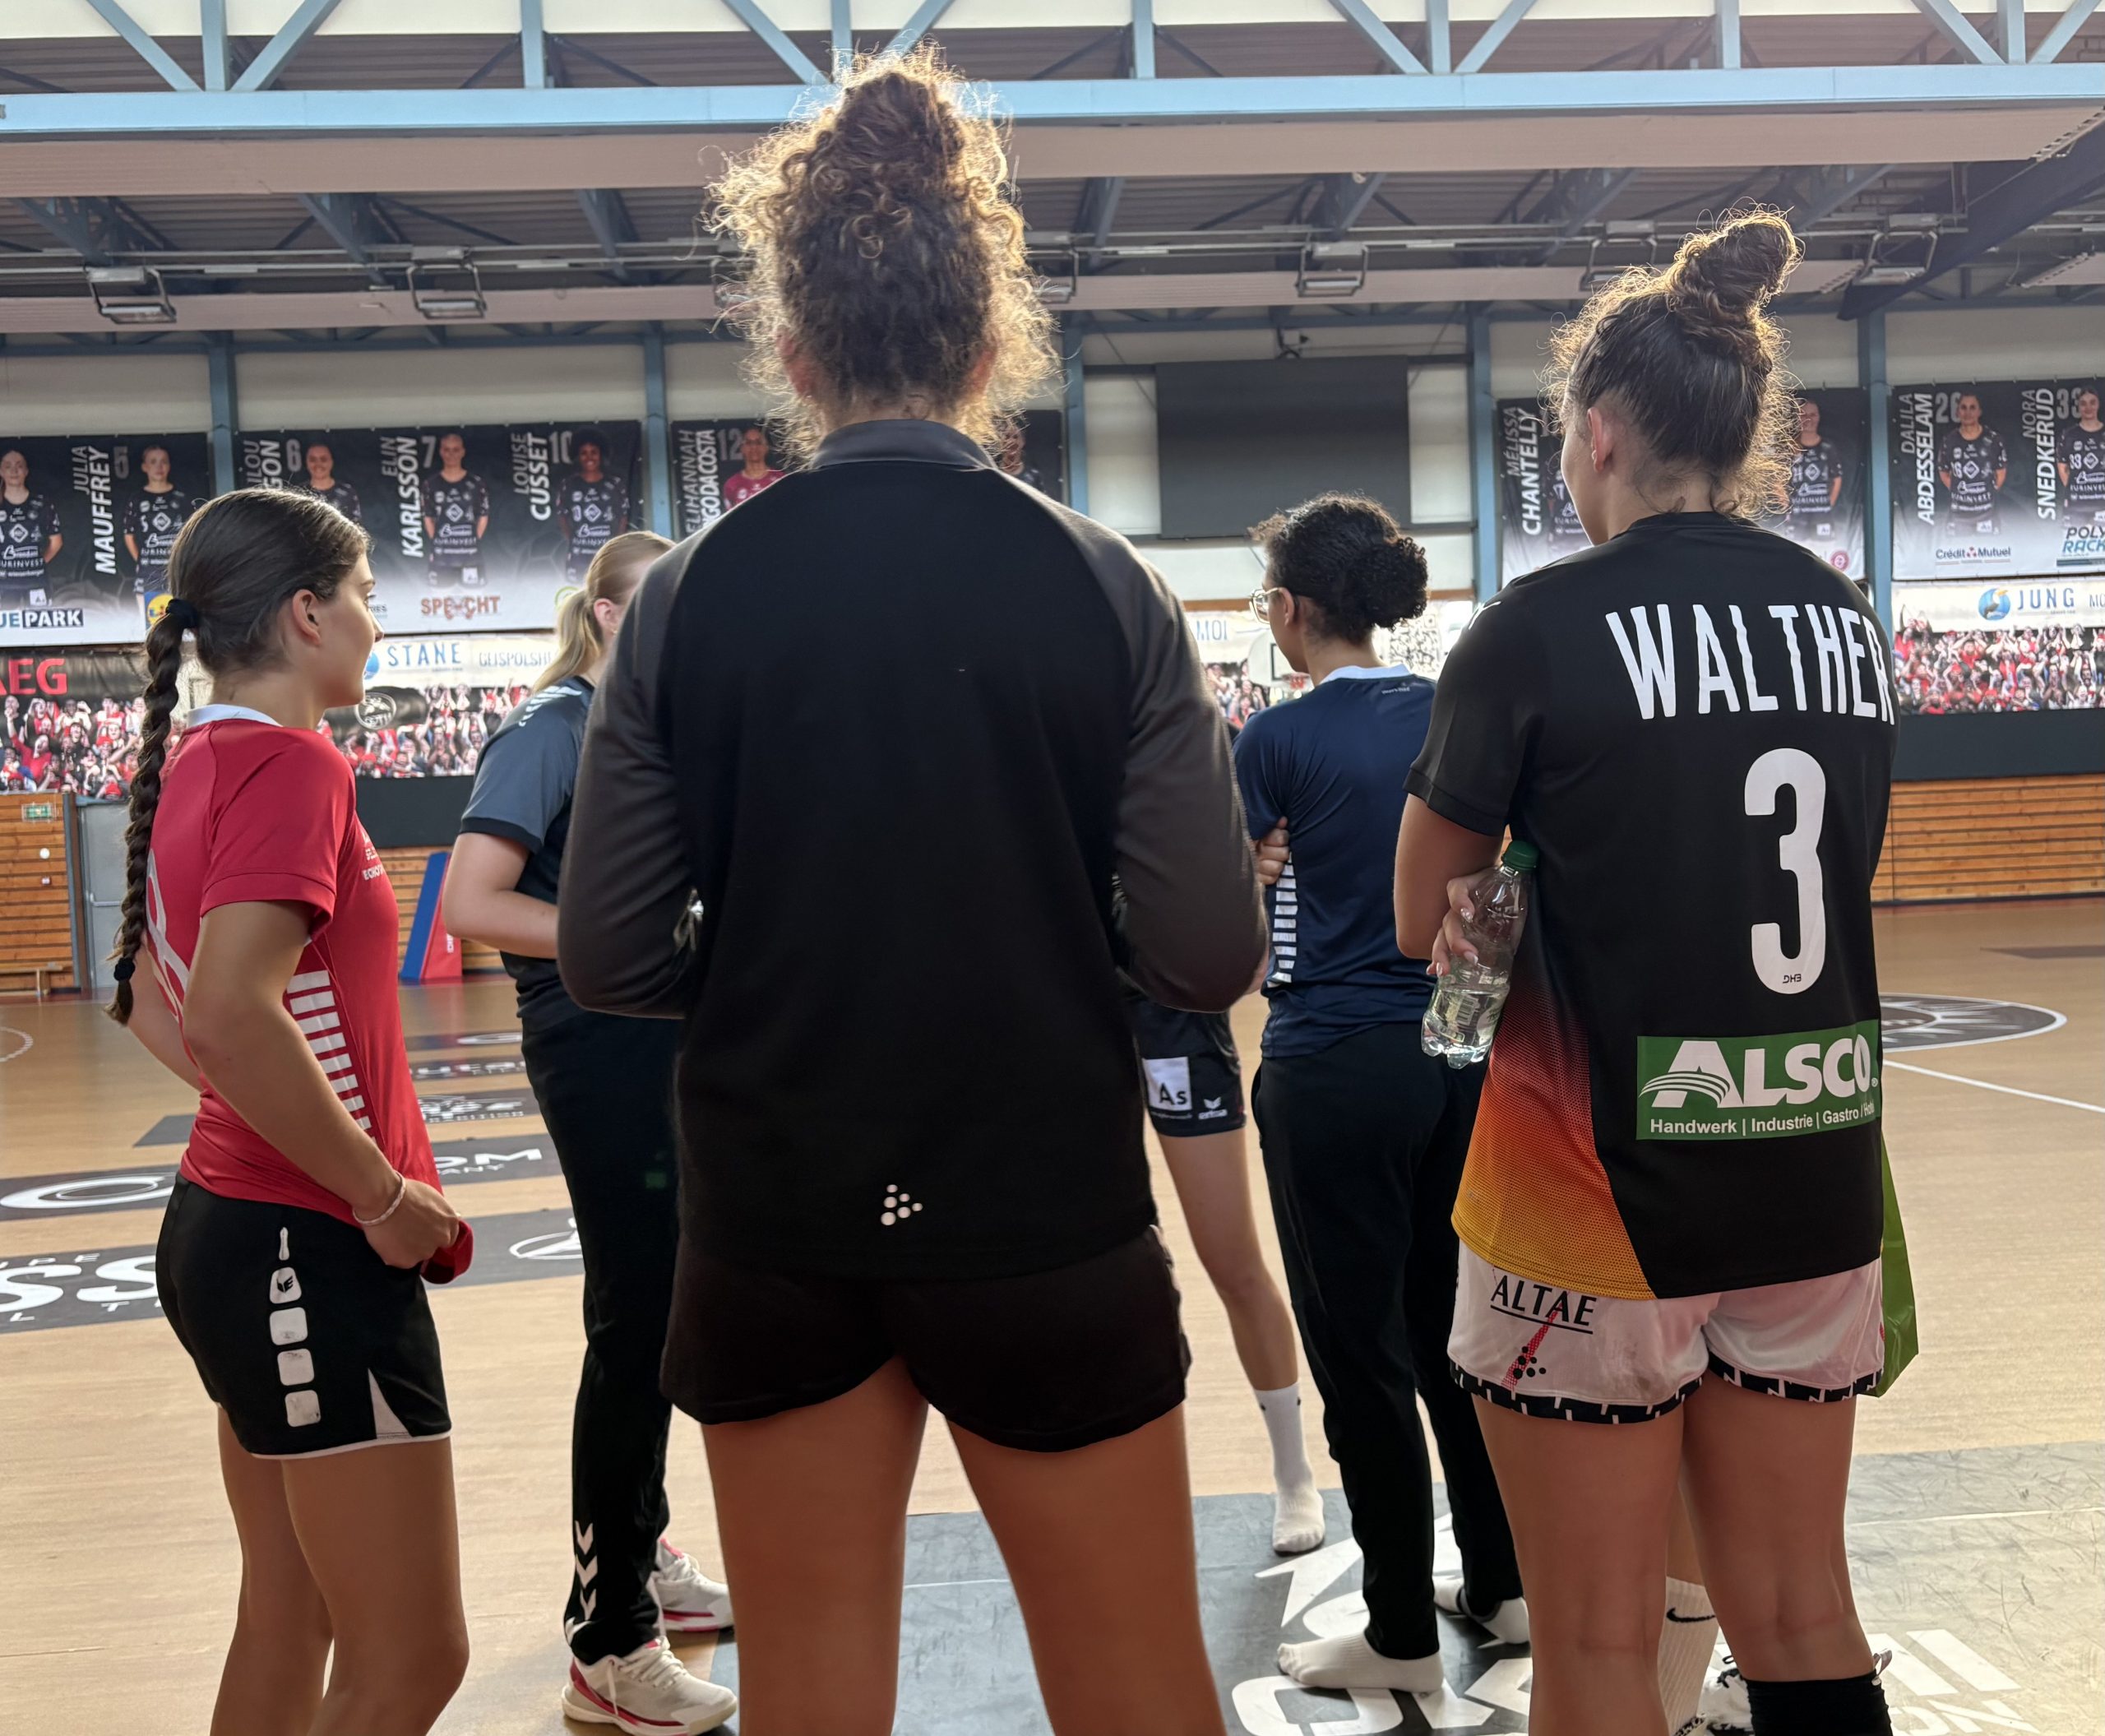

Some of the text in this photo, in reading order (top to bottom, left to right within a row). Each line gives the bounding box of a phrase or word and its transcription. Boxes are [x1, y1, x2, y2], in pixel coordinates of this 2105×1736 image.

[1899, 393, 1915, 453] DALILA
[2021, 389, 2037, 439] NORA
[113, 447, 129, 479] 5
[380, 436, 398, 477] ELIN
[421, 436, 437, 469] 7
[511, 432, 530, 494] LOUISE
[696, 429, 717, 475] COSTA
[717, 428, 743, 461] 12
[1914, 392, 1935, 525] ABDESSELAM
[2035, 388, 2056, 521] SNEDKERUD
[72, 446, 90, 495] JULIA
[527, 432, 551, 521] CUSSET
[1516, 408, 1542, 535] CHANTELLY
[88, 446, 116, 575] MAUFFREY
[396, 436, 423, 558] KARLSSON
[1936, 546, 2011, 559] Crédit Mutuel
[2018, 587, 2075, 610] JUNG
[387, 643, 462, 667] STANE
[1605, 604, 1894, 725] WALTHER
[1744, 748, 1826, 995] 3
[1159, 1082, 1187, 1105] As
[1650, 1118, 1737, 1134] Handwerk
[1751, 1113, 1813, 1132] Industrie
[1822, 1108, 1859, 1124] Gastro
[1490, 1274, 1597, 1327] ALTAE
